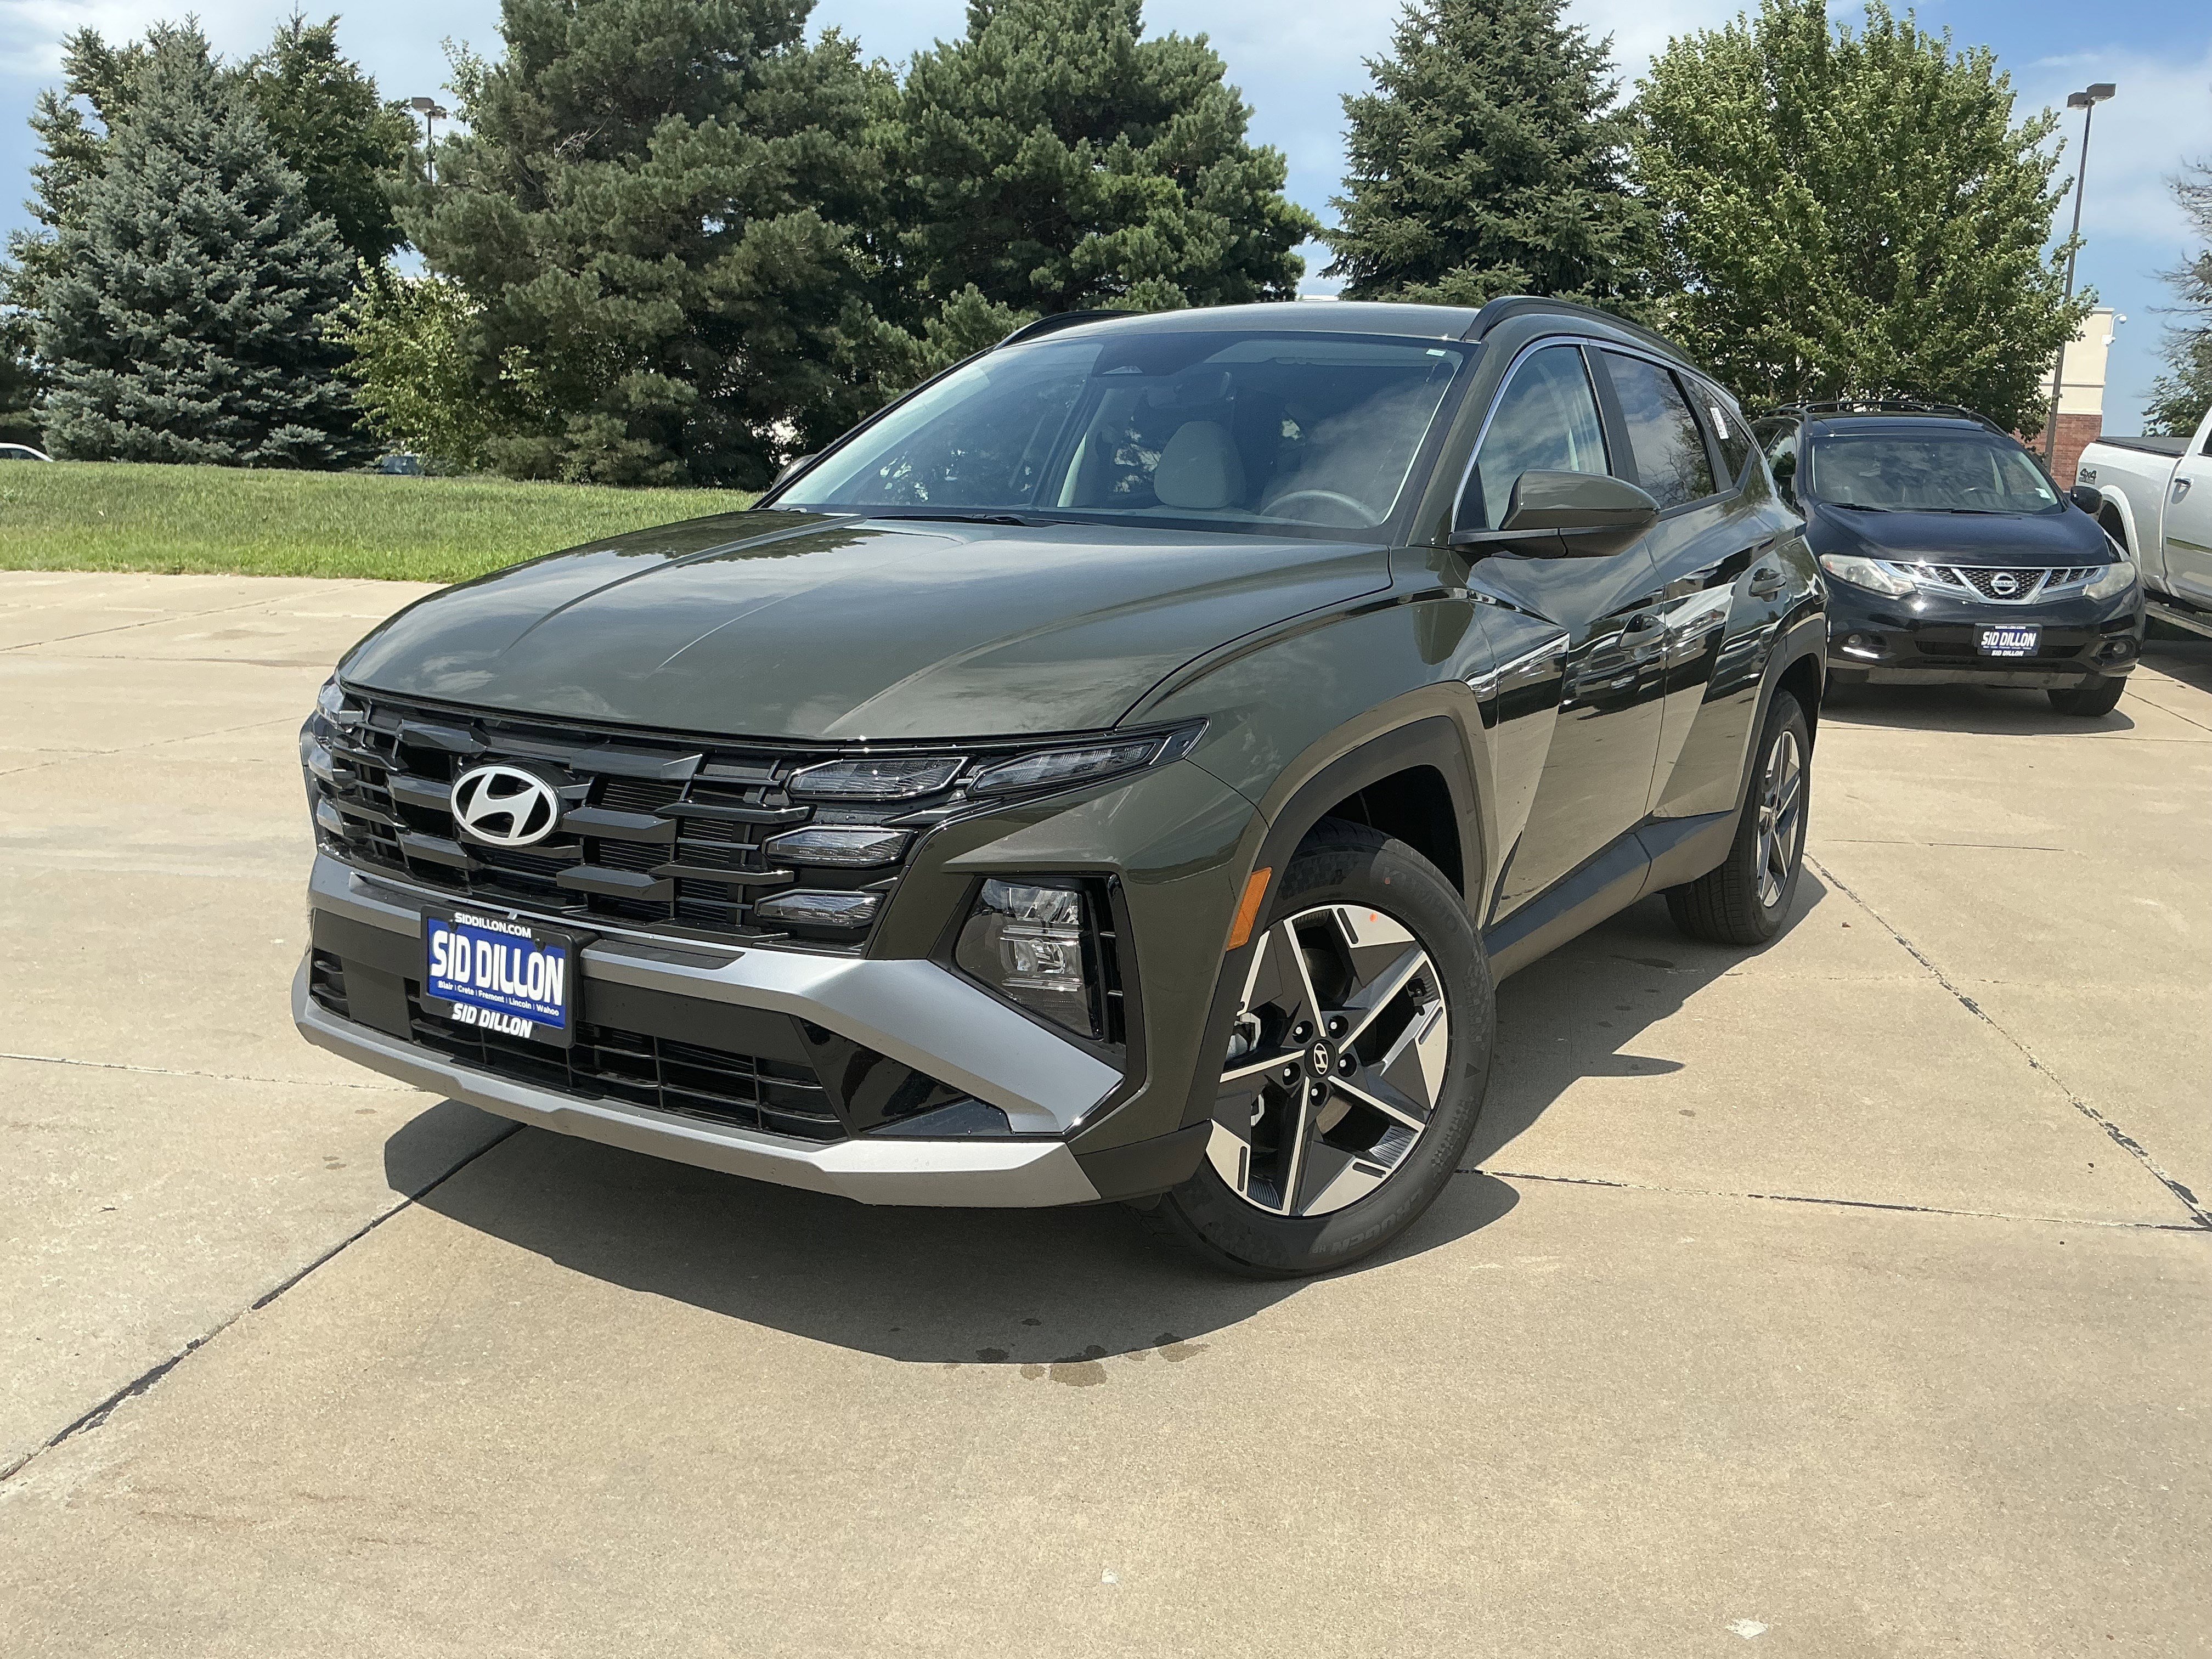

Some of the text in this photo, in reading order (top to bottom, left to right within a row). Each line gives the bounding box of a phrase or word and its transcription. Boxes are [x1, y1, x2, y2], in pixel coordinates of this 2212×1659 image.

[1981, 631, 2036, 647] SID DILLON
[454, 912, 532, 938] SIDDILLON.COM
[430, 930, 564, 1006] SID DILLON
[438, 980, 560, 1017] Blair Crete Fremont Lincoln Wahoo
[452, 1003, 533, 1039] SID DILLON
